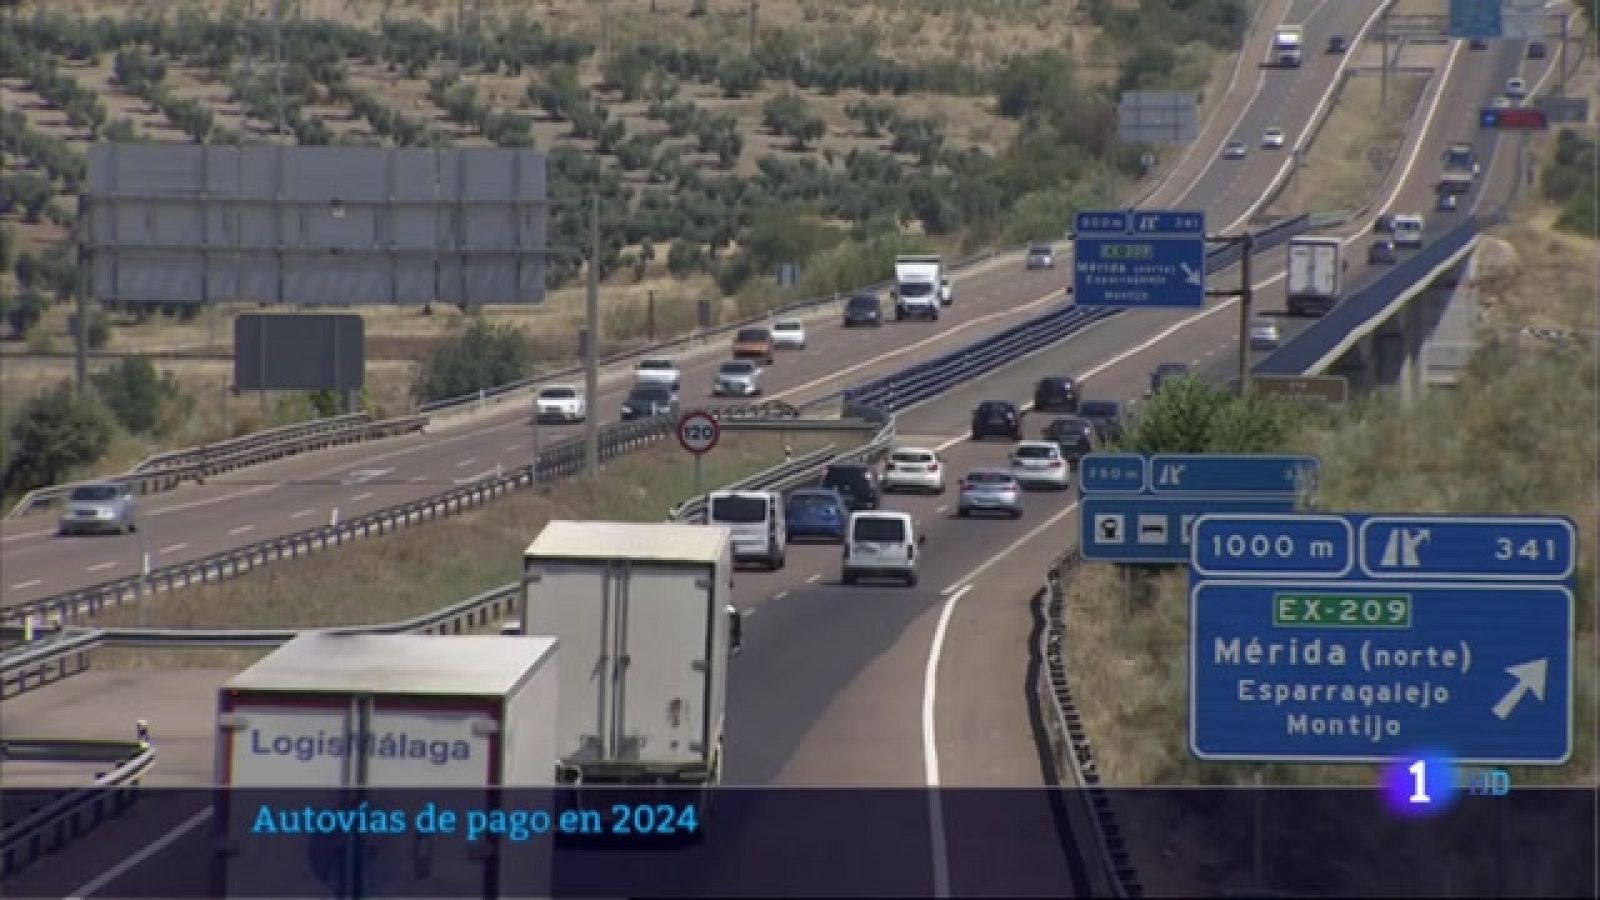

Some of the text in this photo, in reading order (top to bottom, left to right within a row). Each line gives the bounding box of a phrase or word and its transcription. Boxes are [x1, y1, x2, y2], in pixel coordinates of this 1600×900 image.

[684, 424, 713, 441] 120
[1212, 534, 1334, 559] 1000 m
[1494, 537, 1556, 561] 341
[1278, 598, 1408, 623] EX-209
[1214, 636, 1472, 674] Mérida (norte)
[1237, 679, 1450, 709] Esparragalejo
[1286, 712, 1401, 743] Montijo
